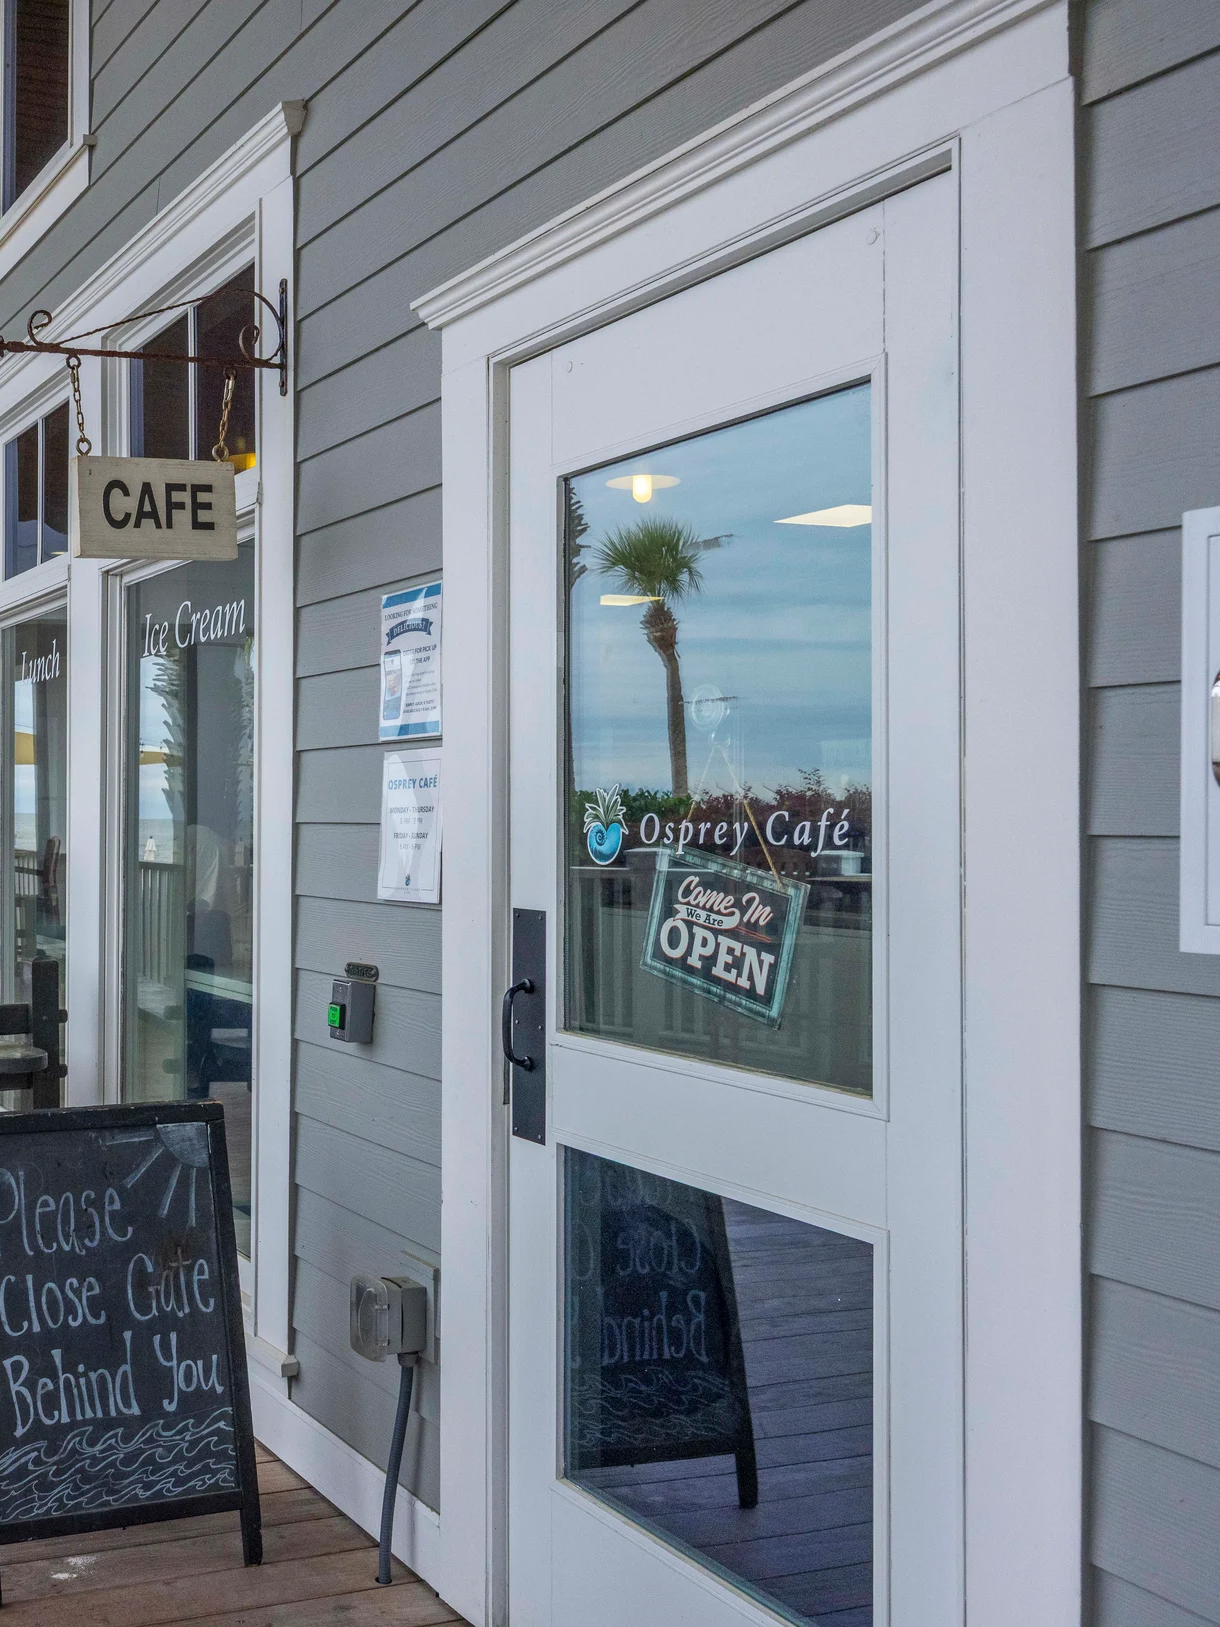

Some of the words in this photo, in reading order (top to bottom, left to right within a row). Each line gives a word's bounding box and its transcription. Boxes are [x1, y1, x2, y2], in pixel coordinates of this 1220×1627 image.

[102, 479, 215, 531] CAFE
[143, 612, 169, 658] Ice
[174, 597, 247, 649] Cream
[384, 611, 403, 621] LOOKING
[393, 621, 426, 636] DELICIOUS?
[21, 638, 61, 686] Lunch
[388, 778, 417, 790] OSPREY
[418, 774, 438, 789] CAFÉ
[412, 805, 435, 813] THURSDAY
[639, 812, 749, 856] Osprey
[765, 807, 850, 857] Café
[677, 875, 736, 917] Come
[741, 891, 774, 926] In
[685, 907, 702, 922] We
[702, 912, 724, 928] Are
[659, 917, 776, 997] OPEN
[0, 1273, 106, 1338] Close
[127, 1246, 215, 1321] Gate
[2, 1330, 141, 1438] Behind
[152, 1330, 225, 1412] You
